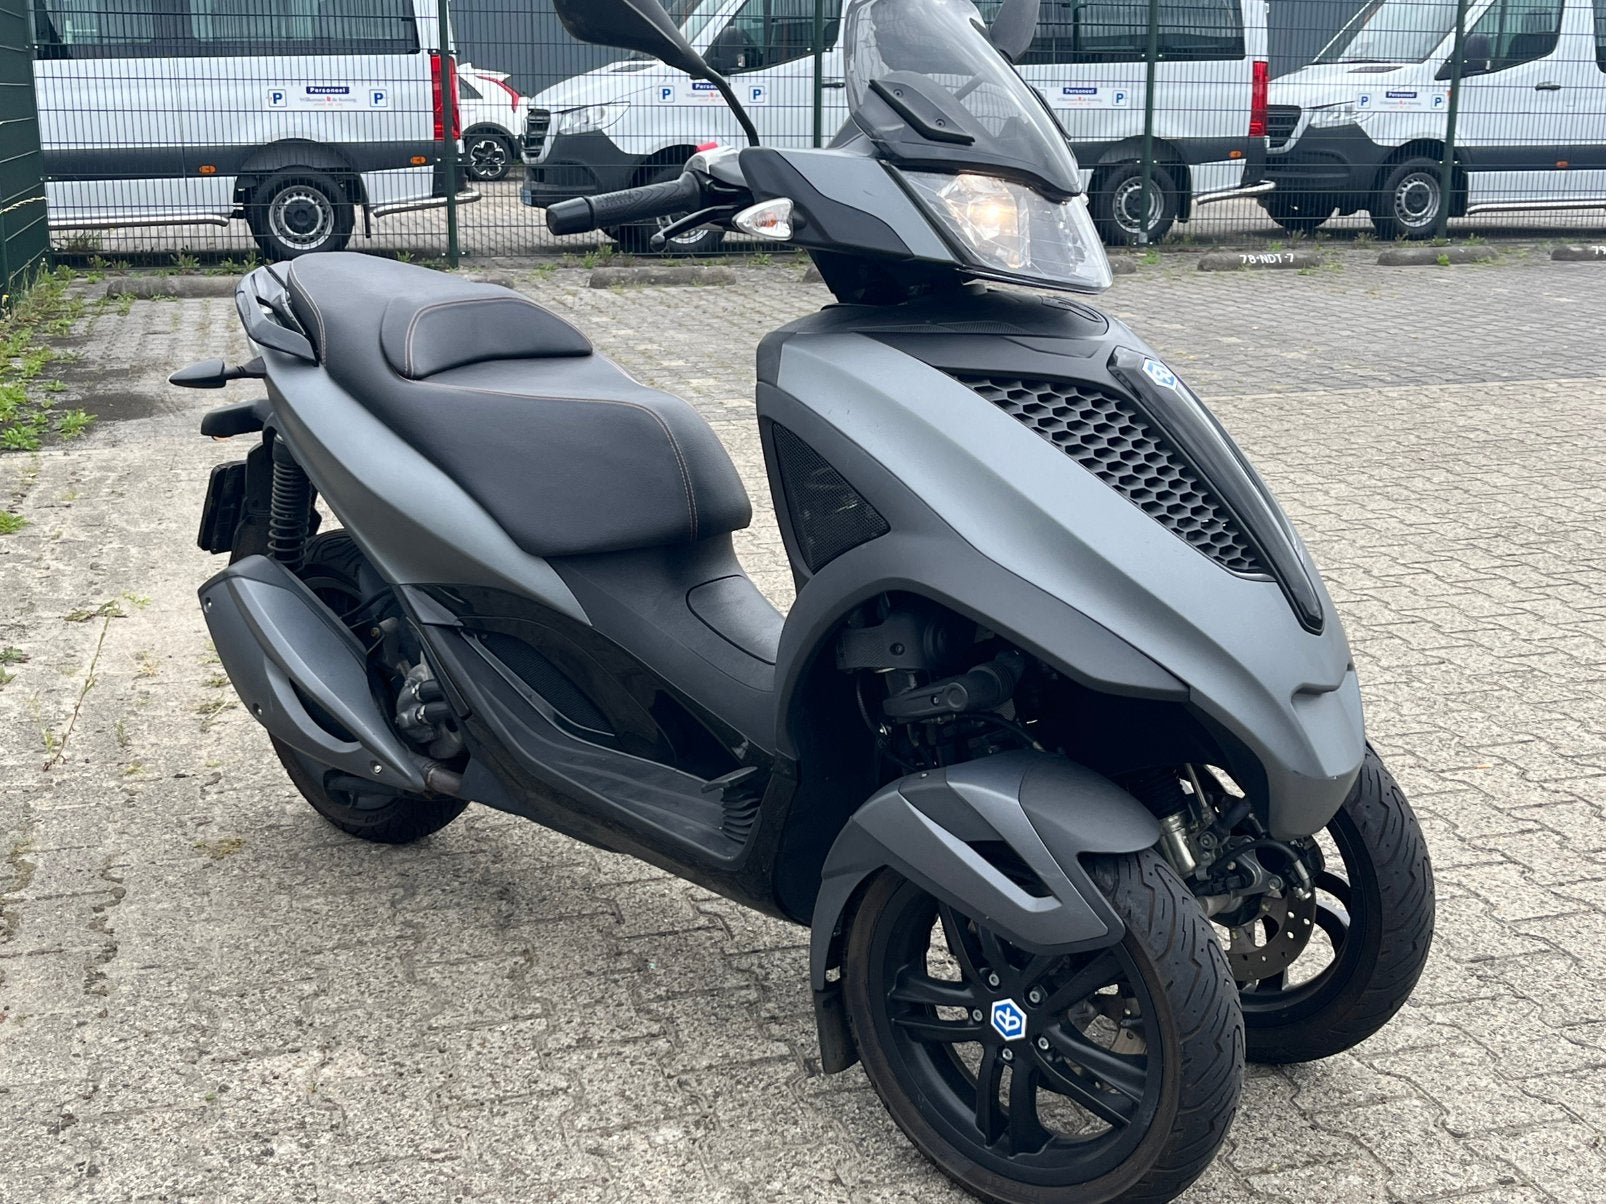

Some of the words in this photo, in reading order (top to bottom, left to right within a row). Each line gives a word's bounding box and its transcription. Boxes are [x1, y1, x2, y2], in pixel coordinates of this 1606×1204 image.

[272, 92, 283, 104] P
[373, 92, 384, 104] P
[662, 88, 671, 100] P
[752, 89, 762, 100] P
[1116, 93, 1124, 104] P
[1360, 96, 1369, 106] P
[1434, 97, 1442, 107] P
